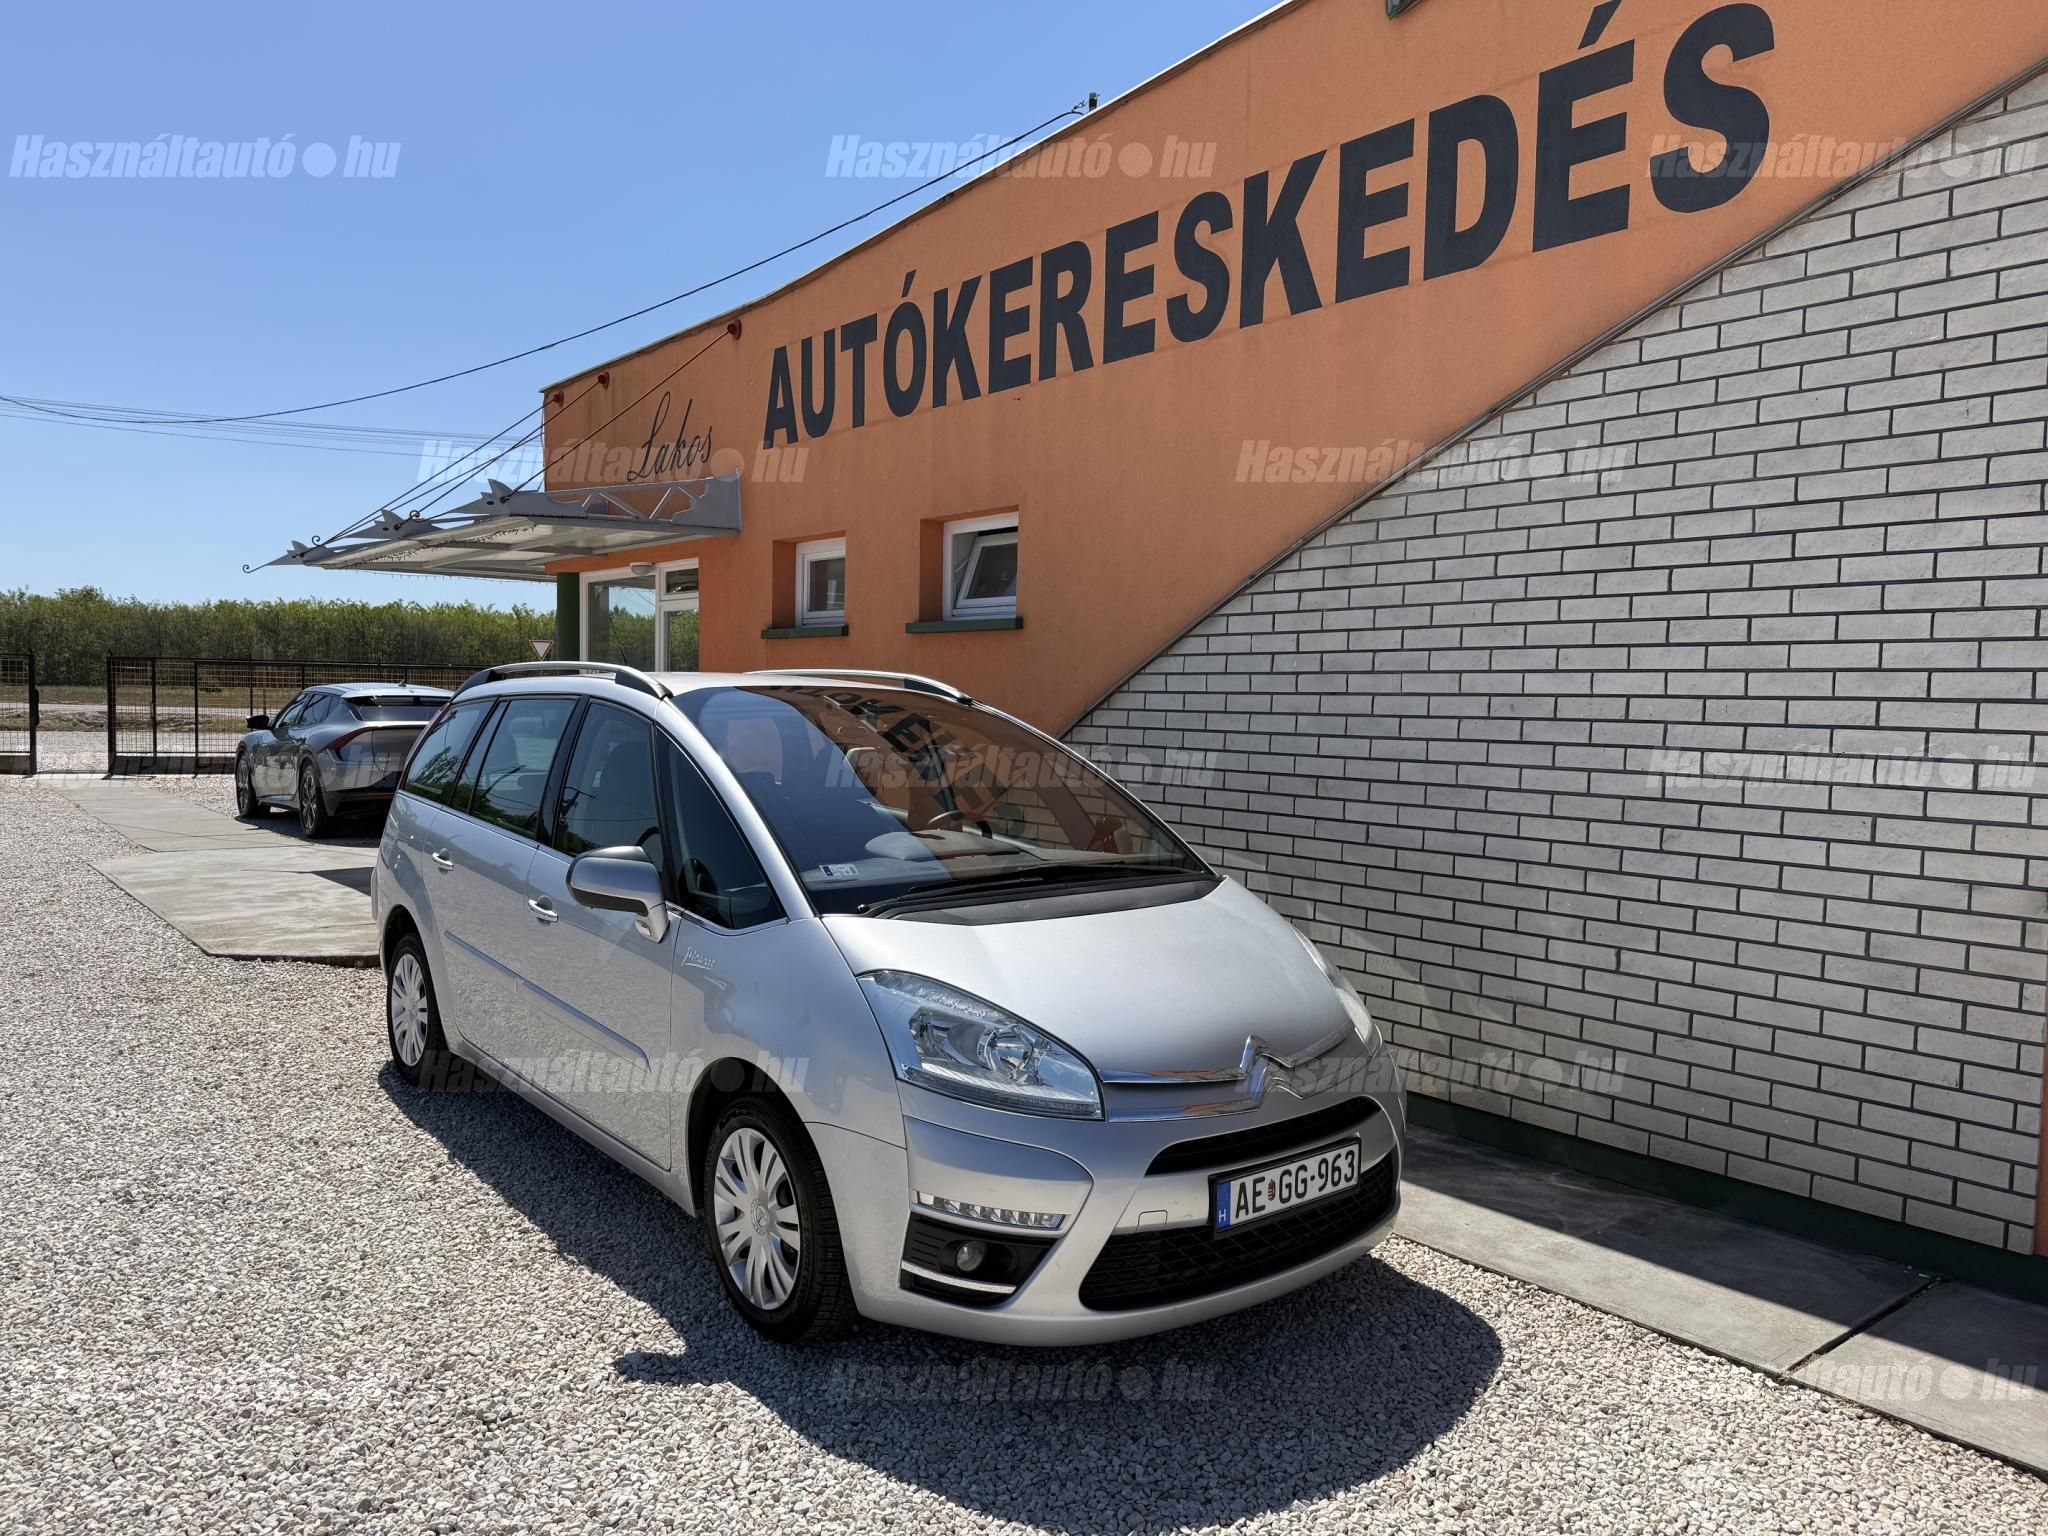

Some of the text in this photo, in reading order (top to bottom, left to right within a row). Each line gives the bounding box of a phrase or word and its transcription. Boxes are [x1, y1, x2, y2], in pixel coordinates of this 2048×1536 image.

[762, 0, 1775, 450] AUTÓKERESKEDÉS
[627, 391, 713, 482] Lakos
[1218, 1208, 1227, 1224] H
[1278, 1149, 1356, 1205] GG-963
